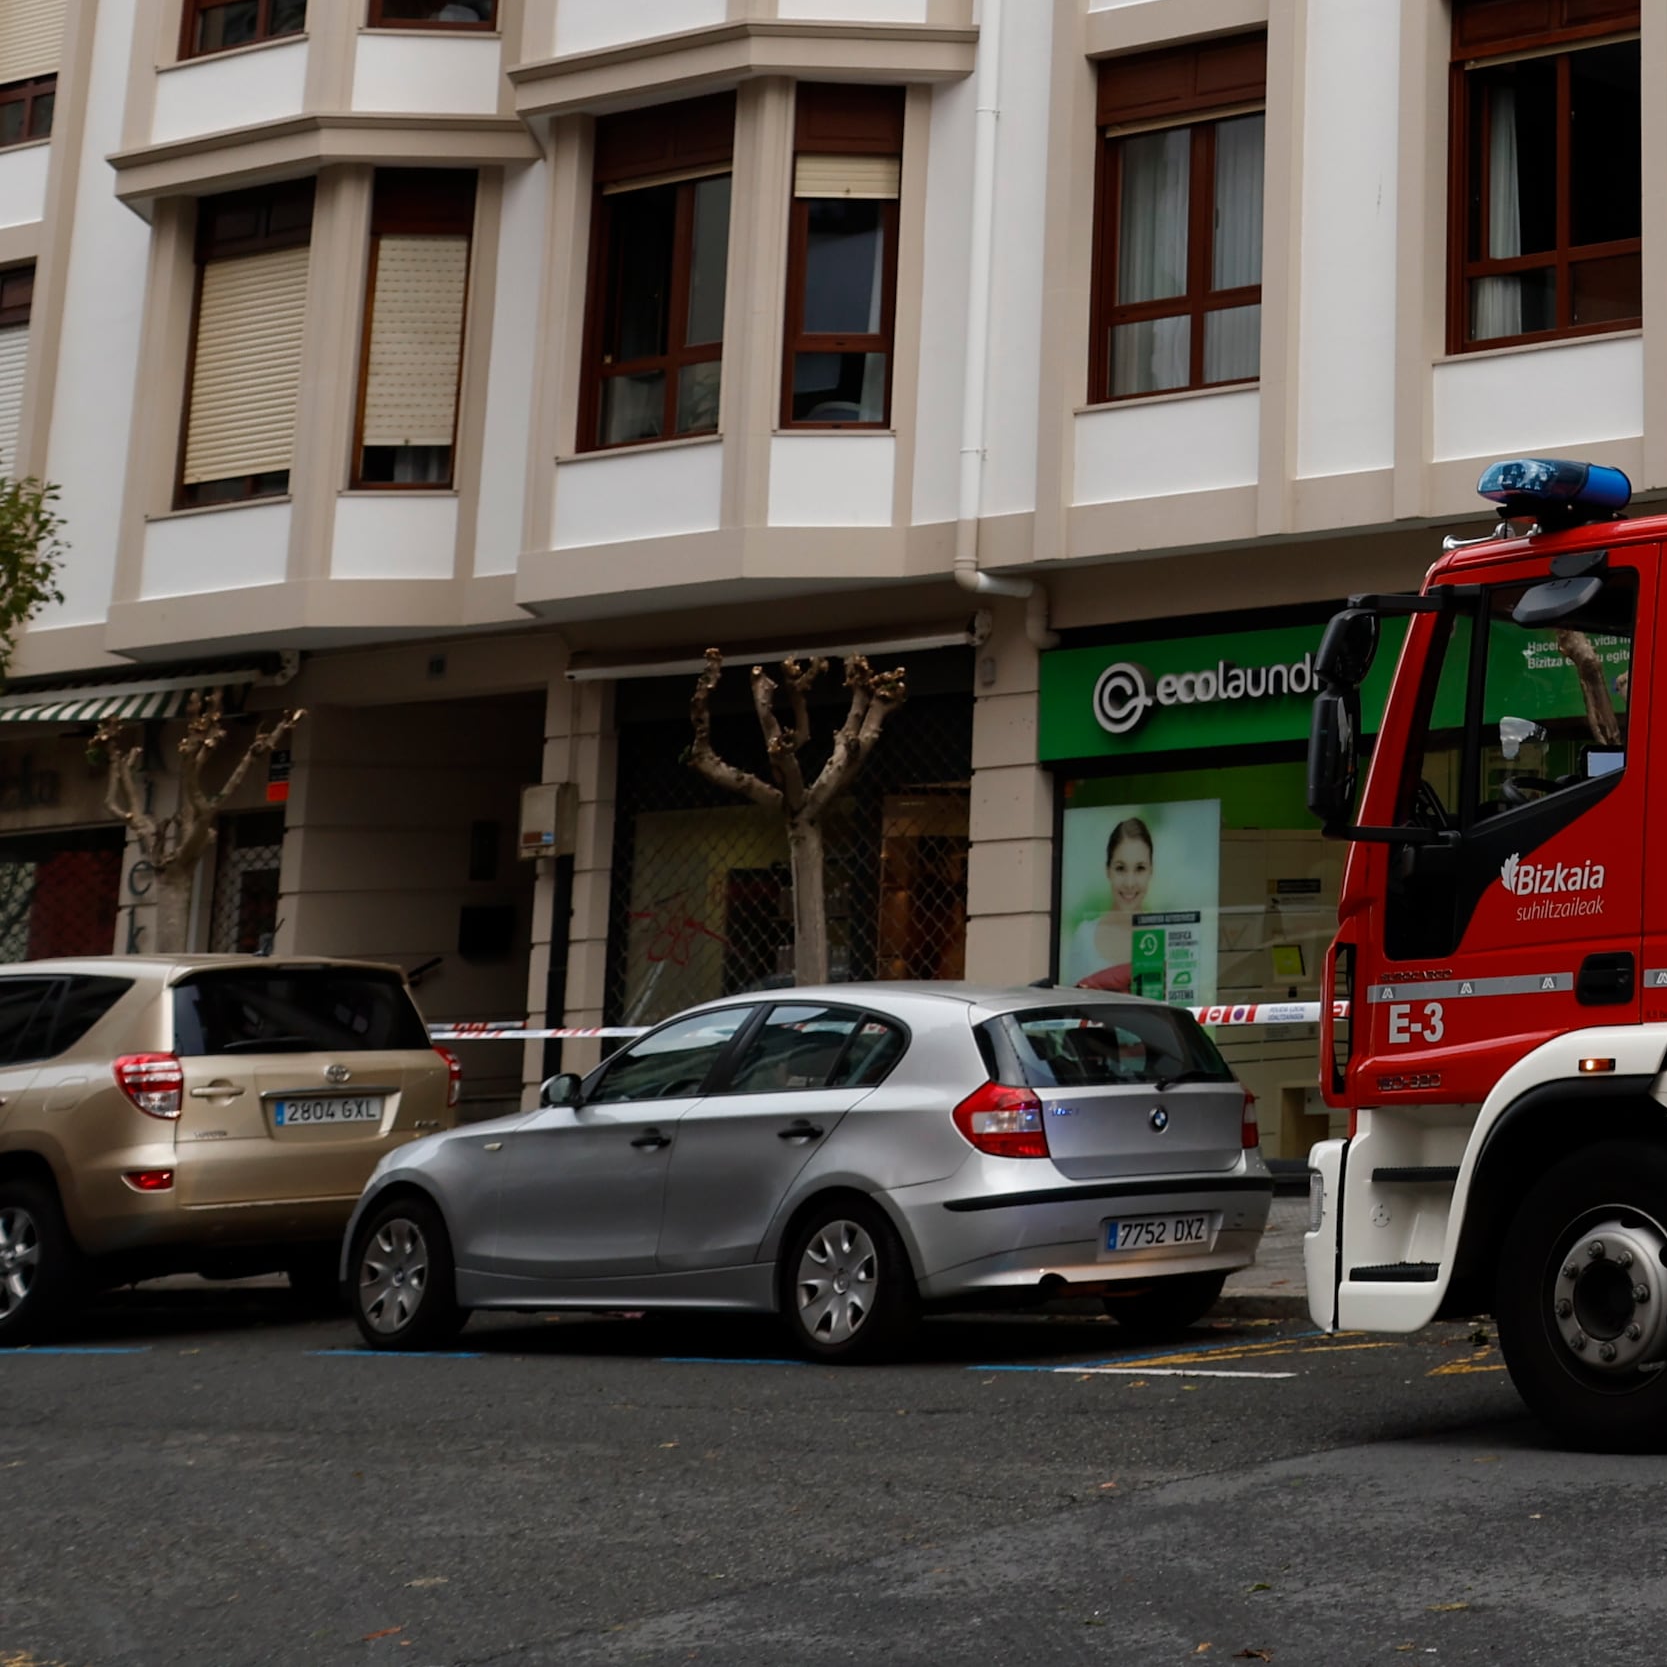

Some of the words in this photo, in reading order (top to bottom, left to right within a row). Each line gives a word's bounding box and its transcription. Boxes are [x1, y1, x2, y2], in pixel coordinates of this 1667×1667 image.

[1516, 859, 1605, 896] Bizkaia
[1515, 895, 1605, 922] suhiltzaileak
[1388, 1001, 1445, 1045] E-3
[287, 1102, 336, 1122] 2804
[341, 1099, 376, 1119] GXL
[1120, 1221, 1166, 1247] 7752
[1173, 1217, 1204, 1242] DXZ
